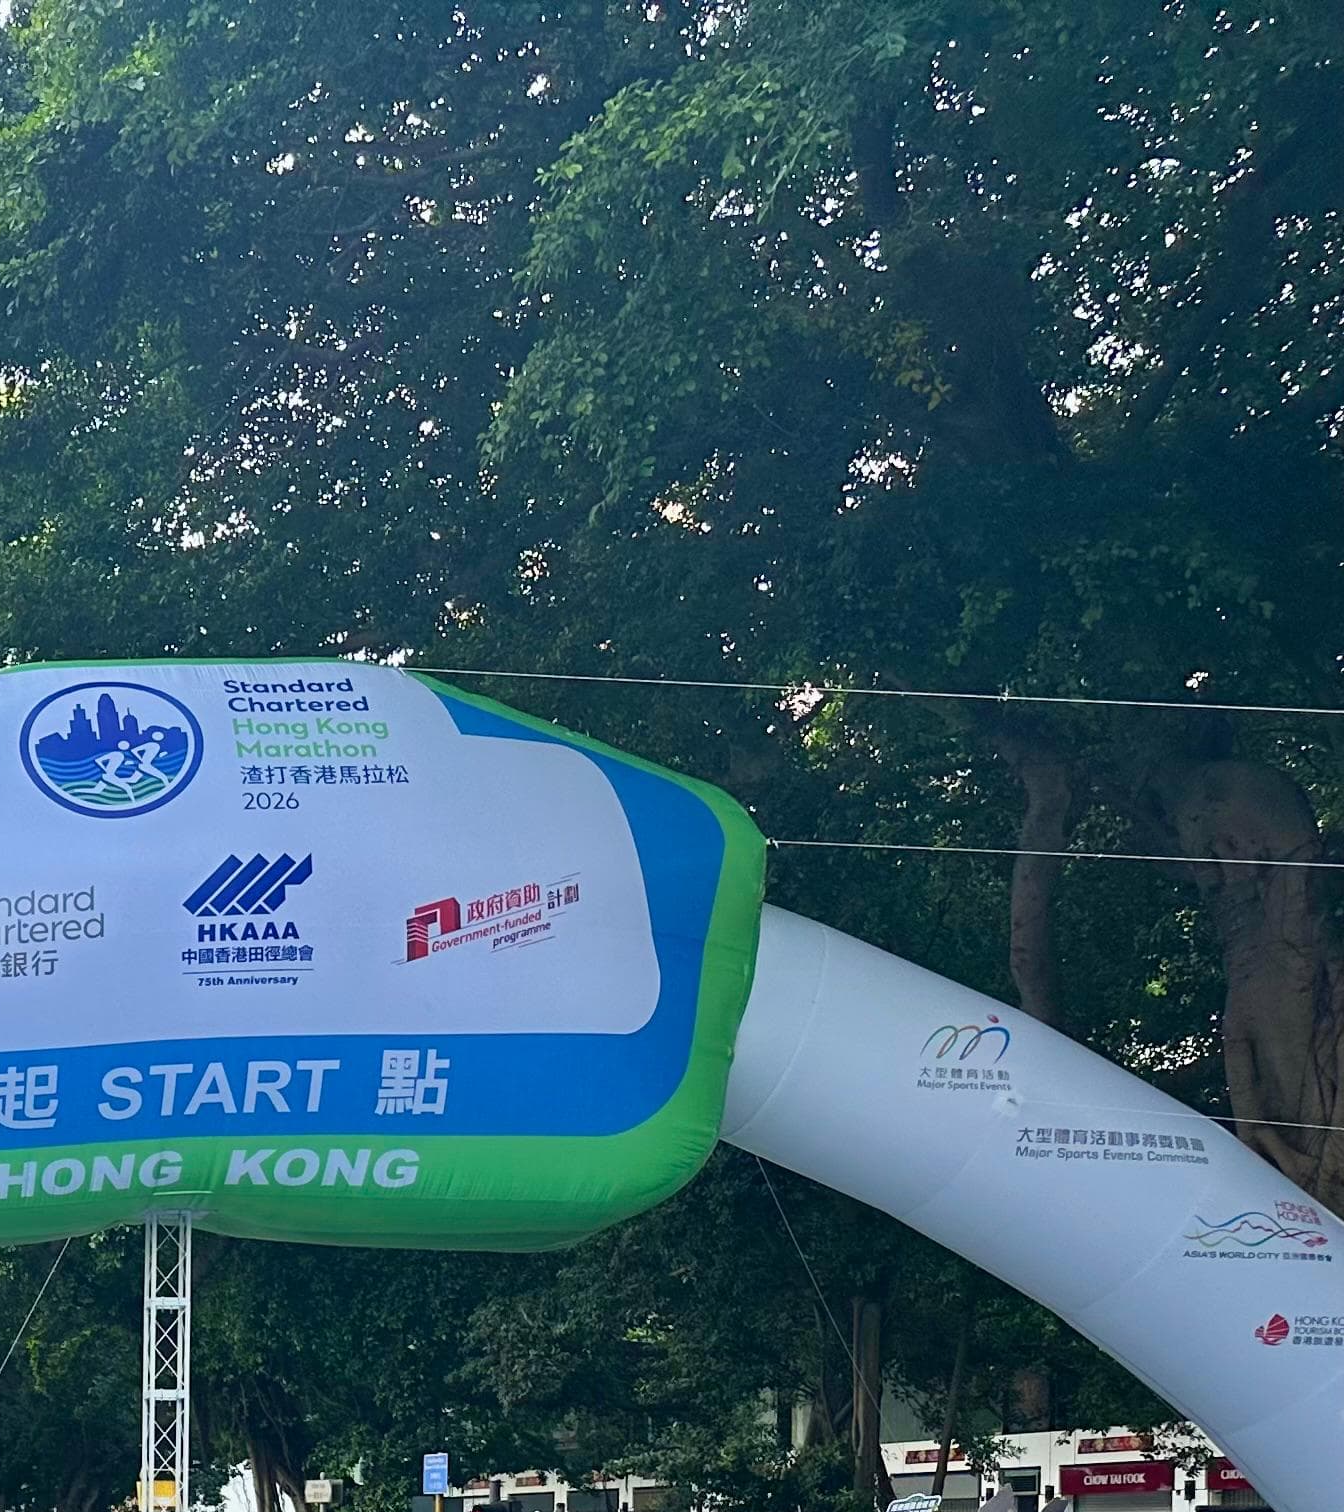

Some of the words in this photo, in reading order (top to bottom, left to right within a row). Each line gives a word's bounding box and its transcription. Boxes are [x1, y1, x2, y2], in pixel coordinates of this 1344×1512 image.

[223, 679, 354, 695] Standard
[228, 696, 369, 713] Chartered
[233, 717, 310, 740] Hong
[316, 717, 389, 740] Kong
[235, 740, 378, 759] Marathon
[240, 765, 410, 786] 渣打香港馬拉松
[242, 792, 300, 811] 2026
[467, 882, 541, 924] 政府資助
[546, 882, 580, 910] 計劃
[197, 921, 300, 943] HKAAA
[431, 909, 542, 953] Government-funded
[492, 921, 551, 949] programme
[197, 976, 224, 987] 75th
[227, 975, 299, 987] Anniversary
[97, 1059, 341, 1120] START
[375, 1048, 452, 1117] 點
[916, 1079, 947, 1090] Major
[947, 1080, 979, 1091] Sports
[980, 1081, 1012, 1091] Events
[1015, 1146, 1053, 1160] Major
[1056, 1147, 1099, 1162] Sports
[1103, 1149, 1144, 1162] Events
[1147, 1150, 1210, 1165] Committee
[223, 1148, 421, 1188] KONG
[1084, 1474, 1109, 1486] CHOW
[1109, 1473, 1122, 1485] TAI
[1123, 1472, 1146, 1484] FOOK
